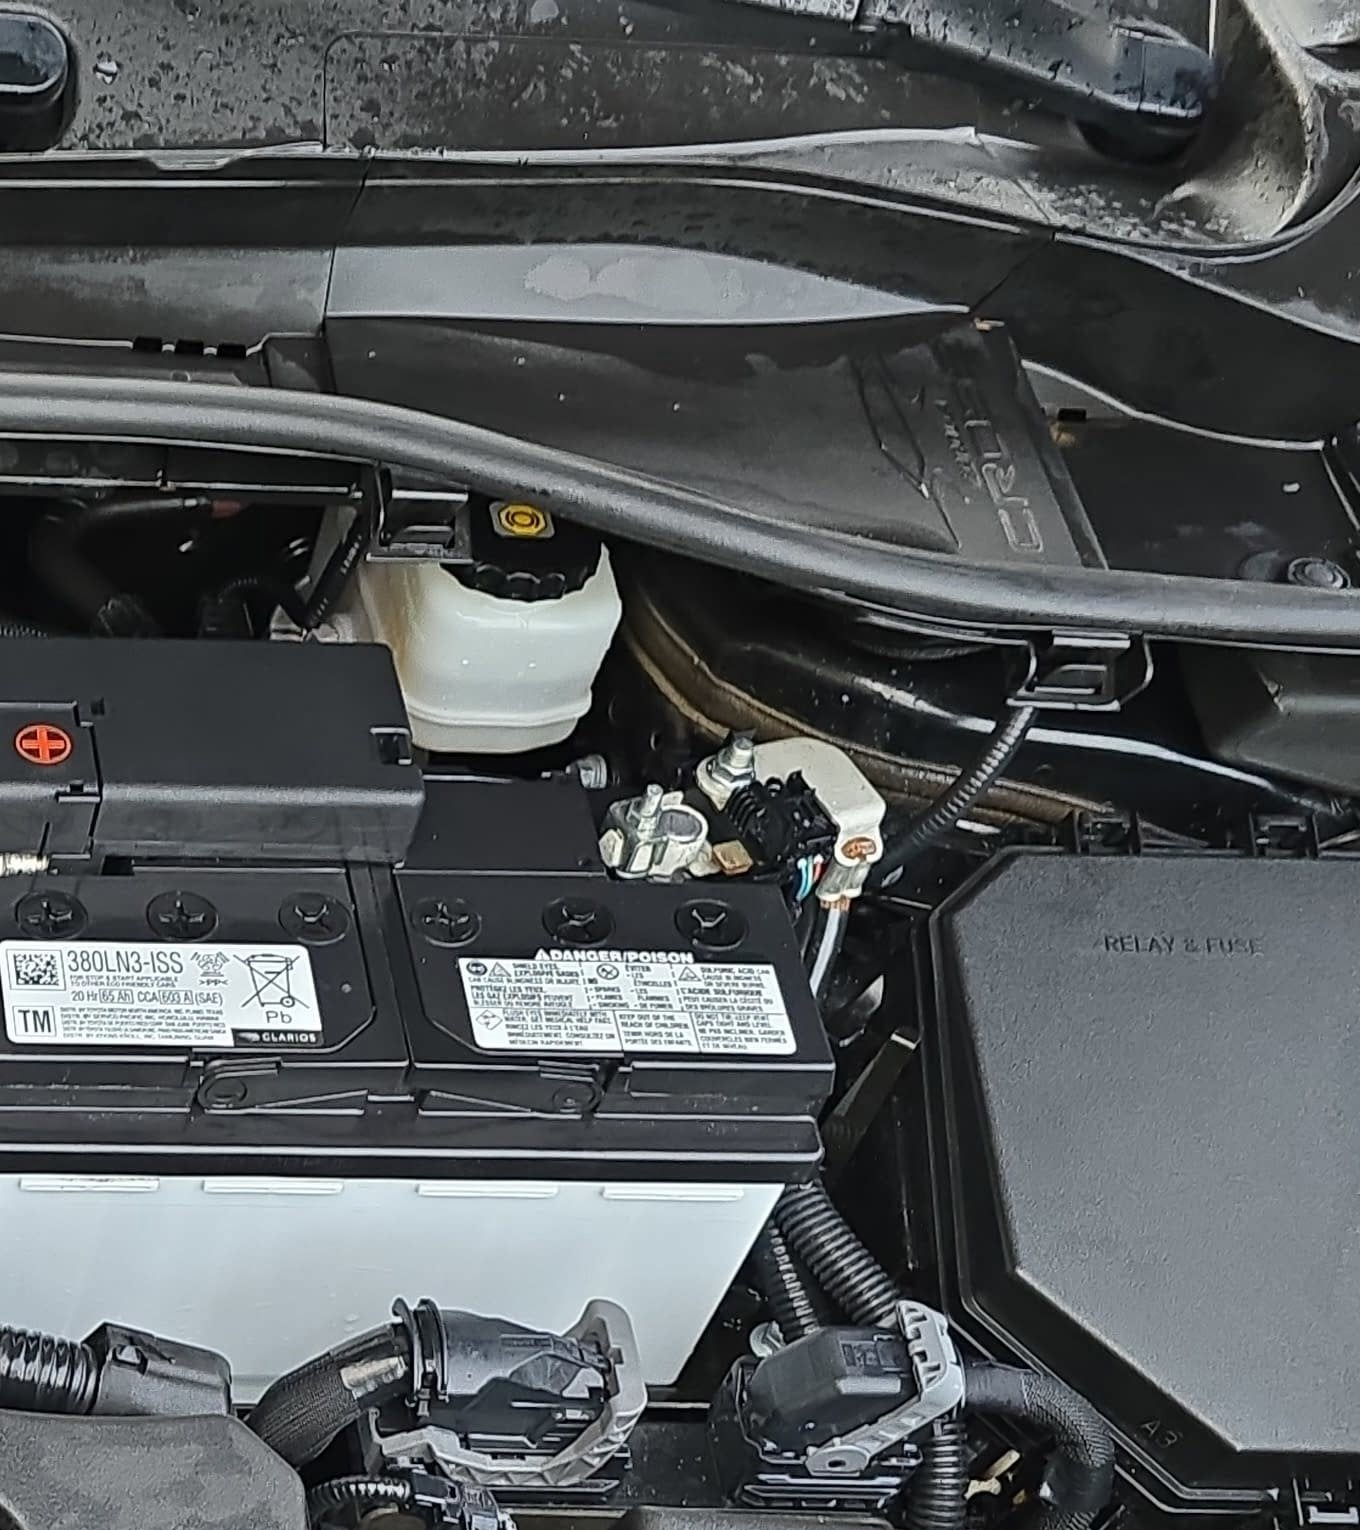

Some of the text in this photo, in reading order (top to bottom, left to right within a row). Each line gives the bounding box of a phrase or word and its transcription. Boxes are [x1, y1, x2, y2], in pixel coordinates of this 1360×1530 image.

[1104, 935, 1174, 953] RELAY
[1206, 936, 1264, 956] FUSE
[66, 950, 184, 974] 380LN3-ISS
[549, 949, 694, 964] DANGER/POISON
[71, 991, 84, 1001] 20
[137, 992, 158, 1002] CCA
[194, 992, 223, 1006] (SAE)
[18, 1009, 52, 1034] TM
[265, 1010, 294, 1025] Pb
[262, 1031, 317, 1044] CLARIOS
